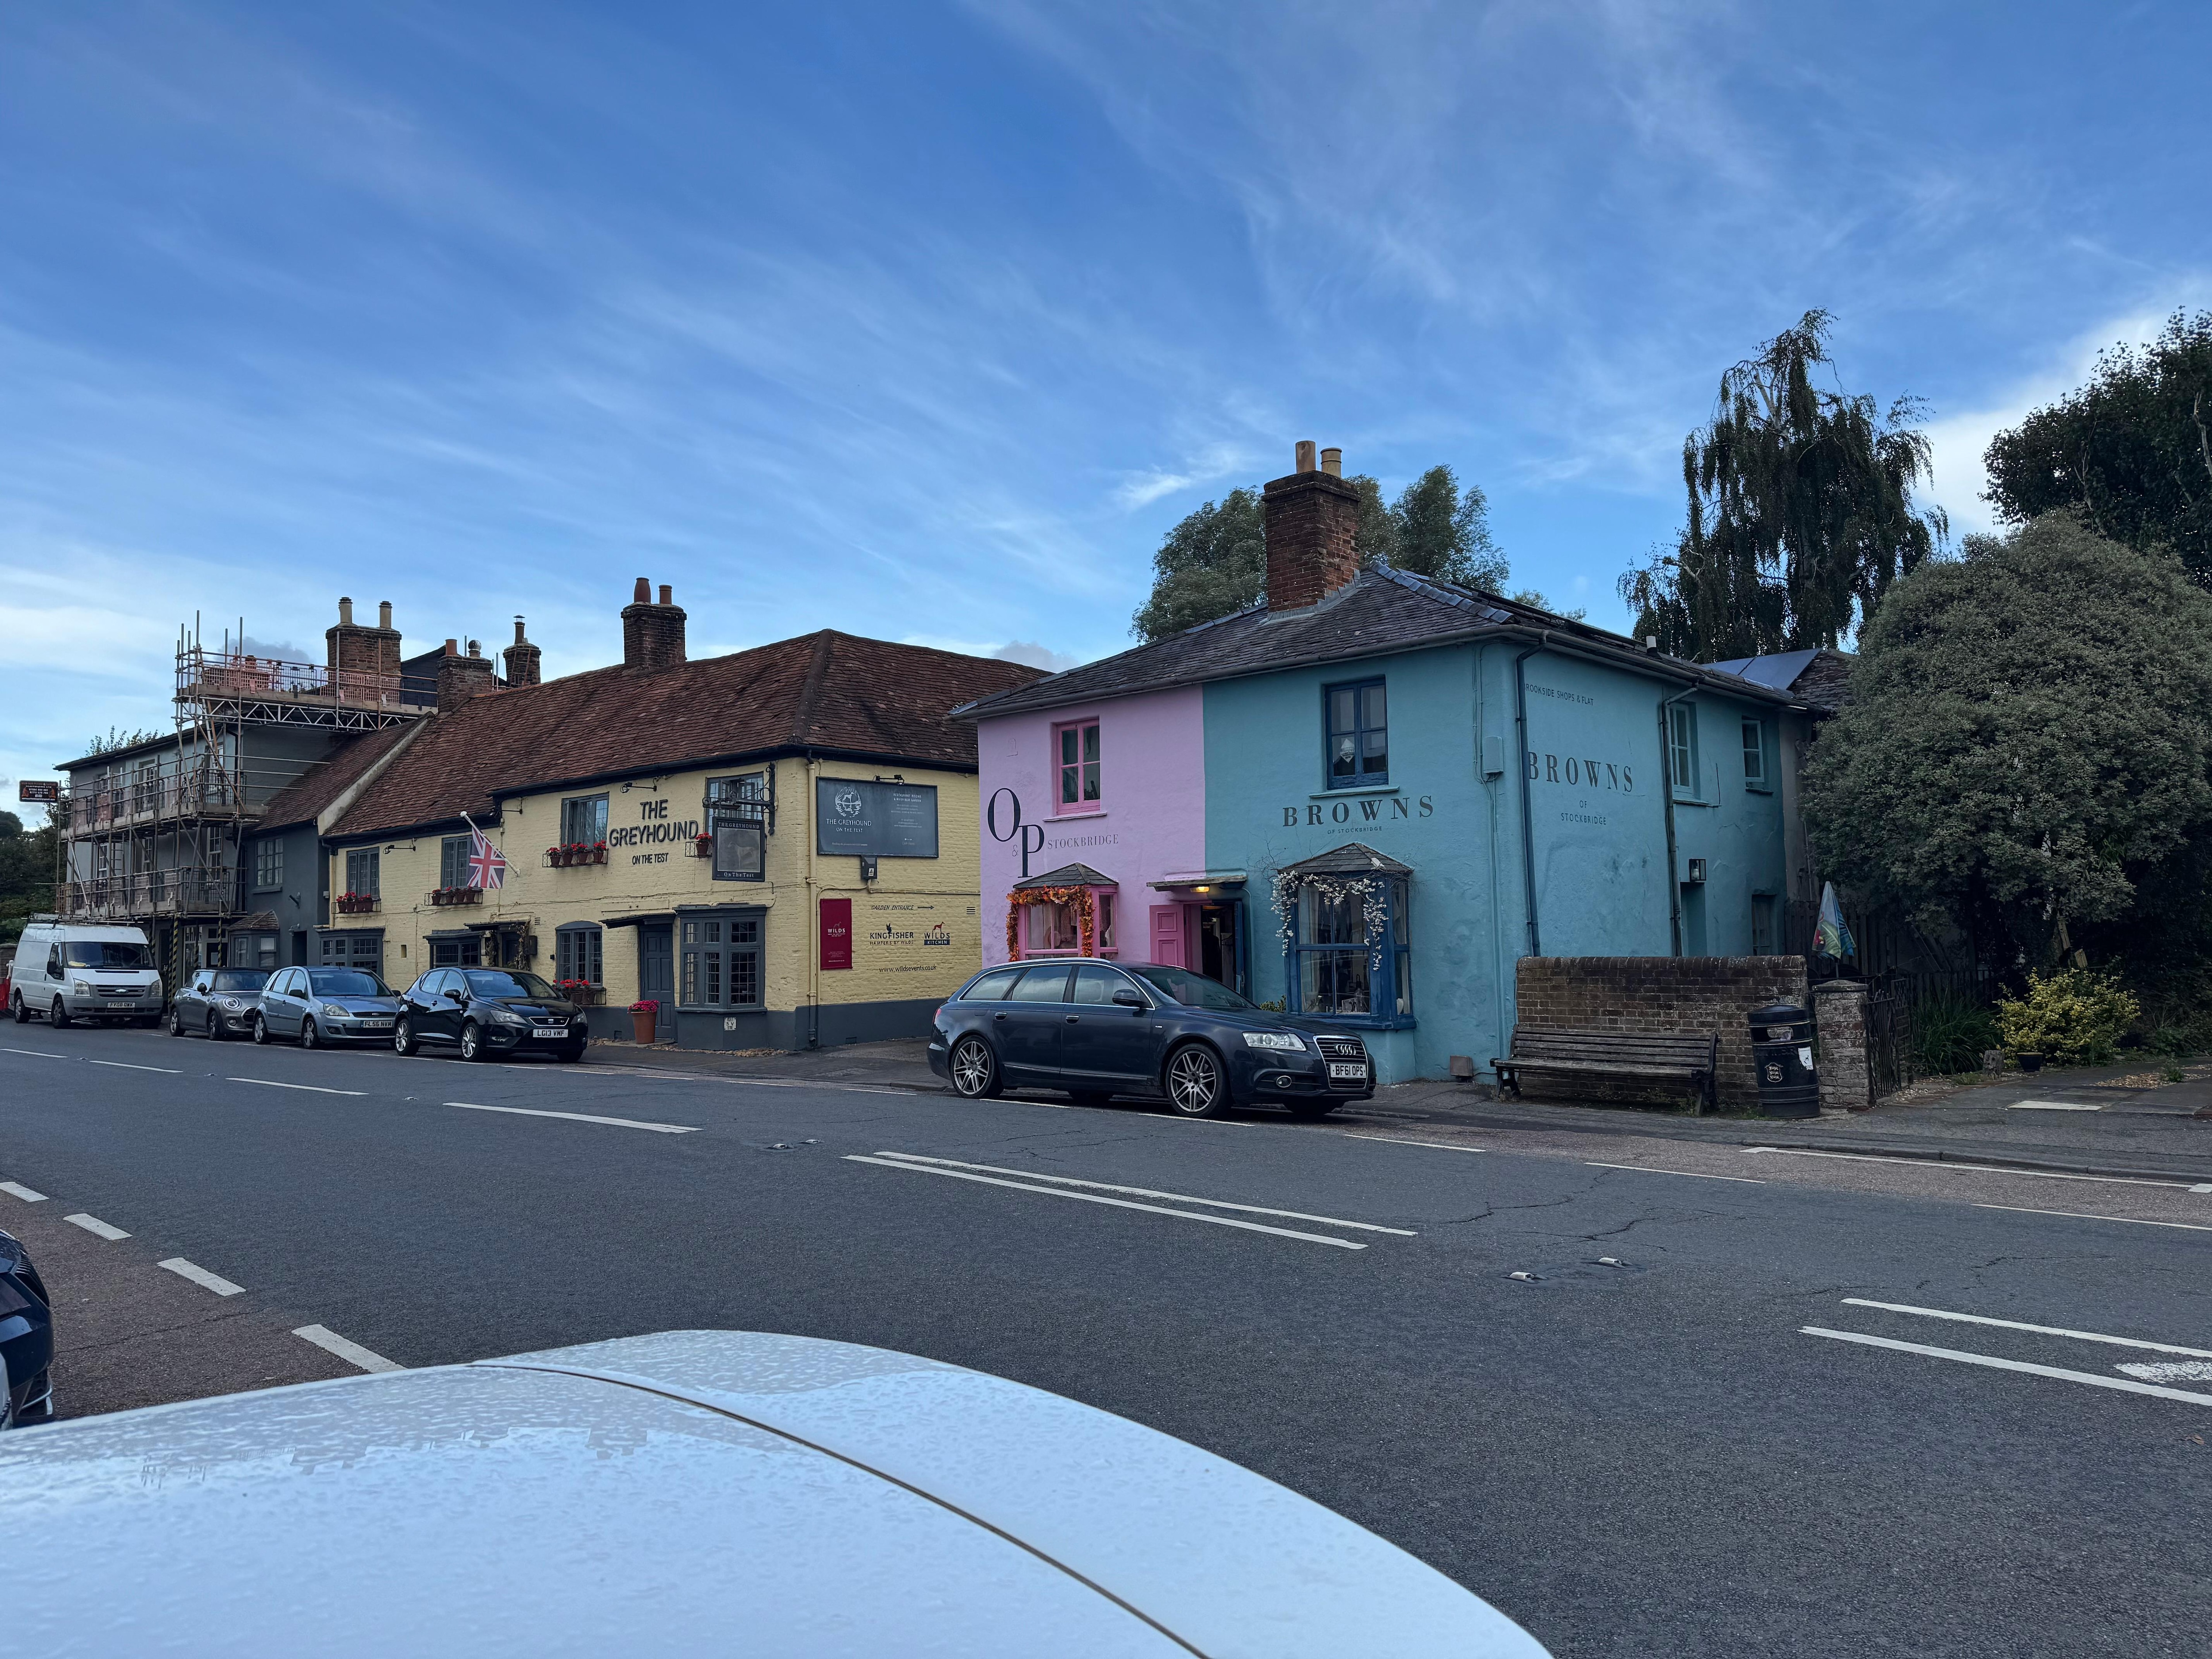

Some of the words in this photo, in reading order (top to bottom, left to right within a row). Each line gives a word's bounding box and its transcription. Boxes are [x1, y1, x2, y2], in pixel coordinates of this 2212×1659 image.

[1526, 684, 1554, 697] ROOKSIDE
[1557, 691, 1574, 701] SHOPS
[1582, 696, 1594, 706] FLAT
[1528, 752, 1632, 792] BROWNS
[640, 799, 668, 820] THE
[1283, 795, 1433, 827] BROWNS
[1561, 813, 1606, 825] STOCKBRIDGE
[609, 820, 699, 847] GREYHOUND
[987, 788, 1021, 842] O
[1012, 845, 1018, 856] &
[1018, 824, 1045, 878] P
[1048, 834, 1119, 849] STOCKBRIDGE
[632, 855, 641, 865] ON
[641, 854, 653, 864] THE
[654, 853, 669, 863] TEST
[879, 964, 937, 973] www.wildsevents.co.uk
[1336, 1065, 1350, 1075] BF61
[1352, 1066, 1363, 1075] OPS
